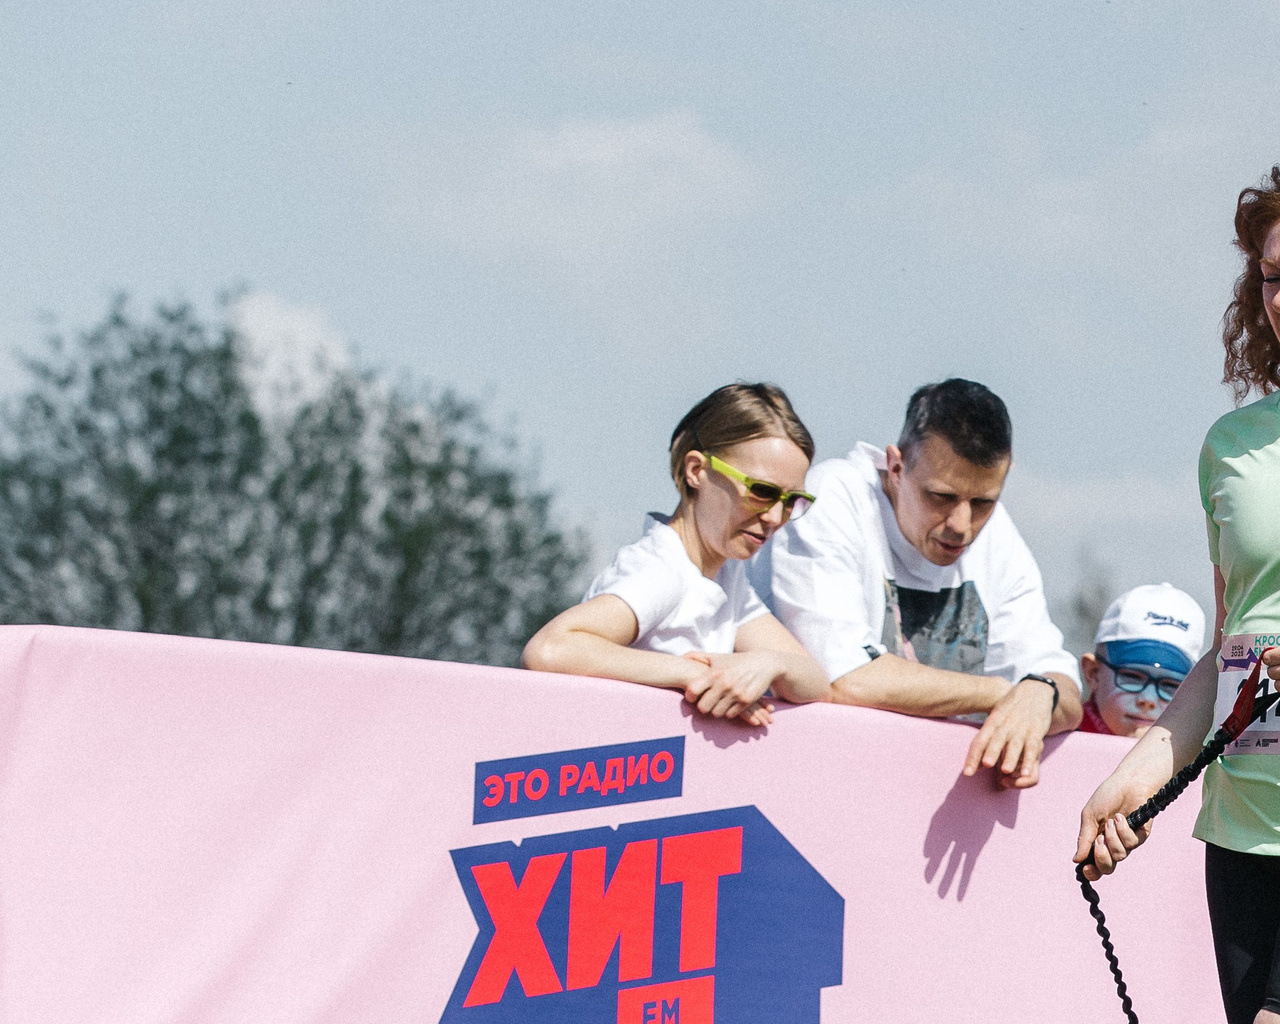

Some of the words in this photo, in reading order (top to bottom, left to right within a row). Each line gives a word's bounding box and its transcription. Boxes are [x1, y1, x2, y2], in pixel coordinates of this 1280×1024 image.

[482, 768, 550, 807] ЭТО
[558, 751, 675, 797] РАДИО
[462, 826, 744, 1008] ХИТ
